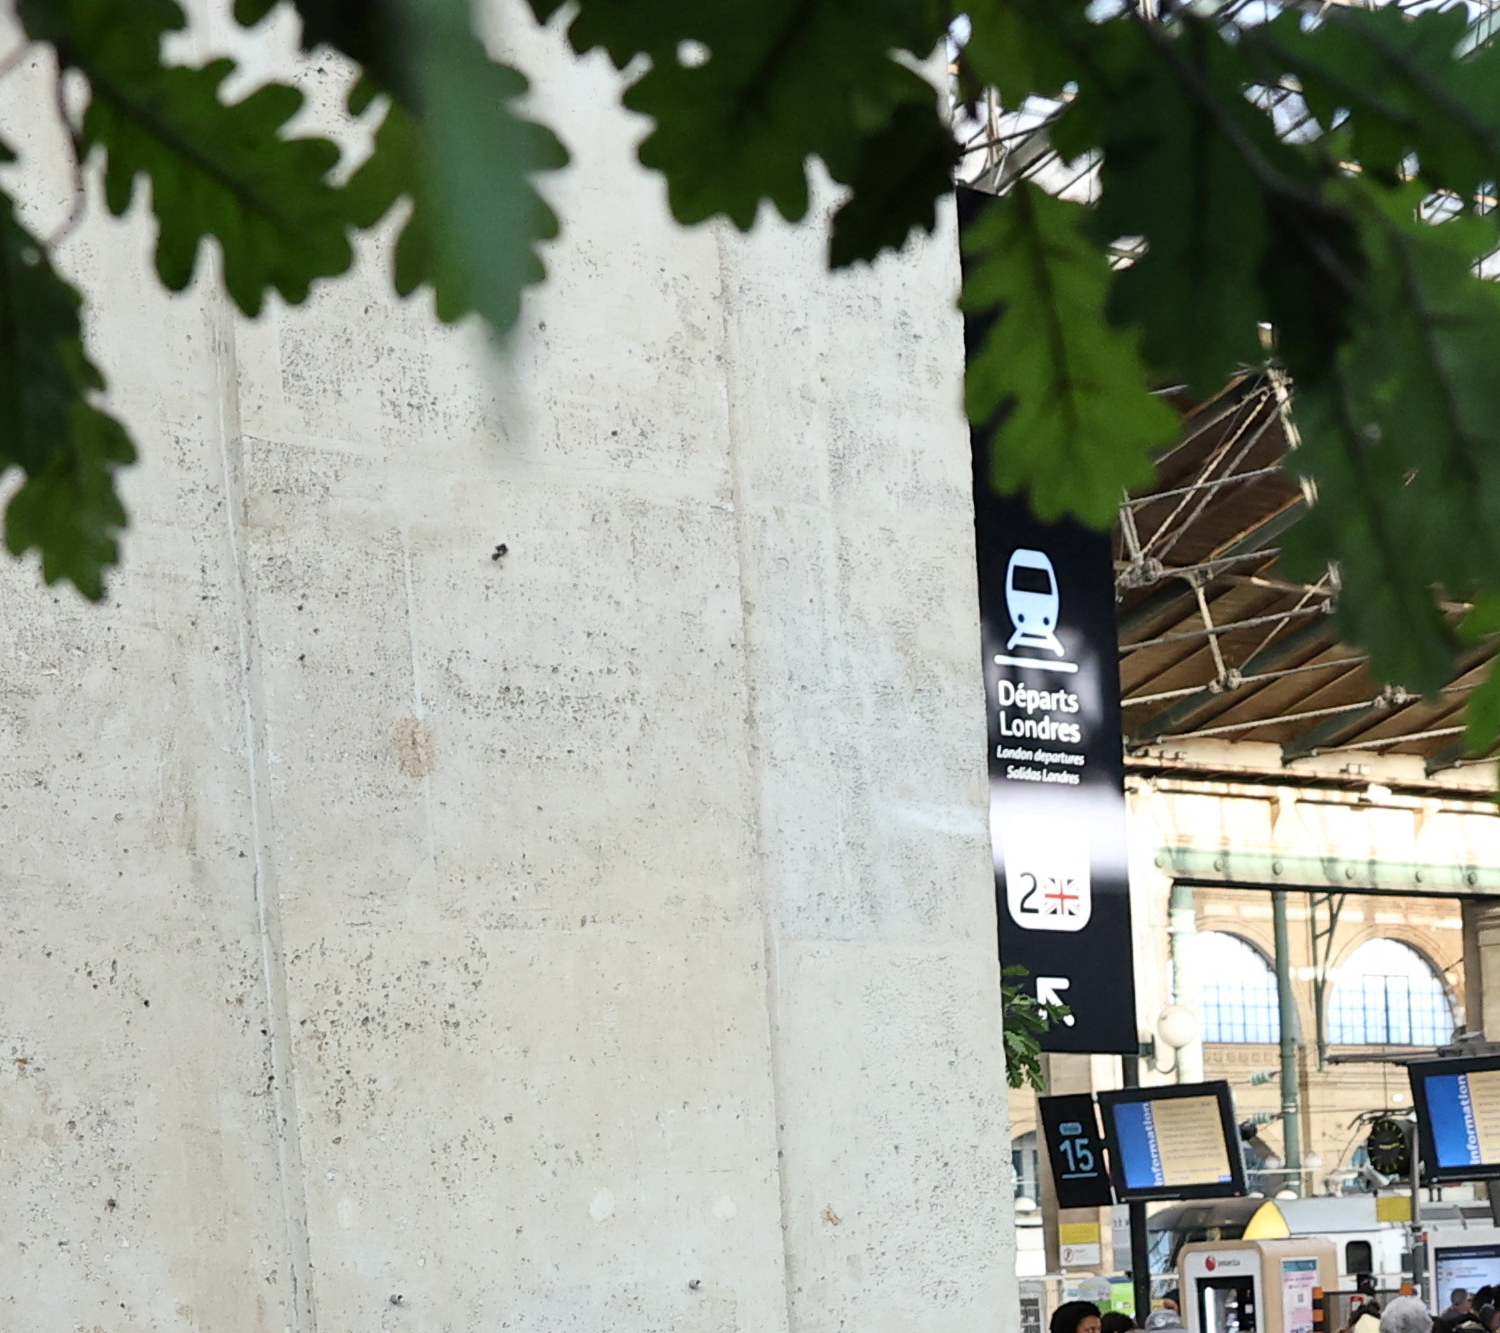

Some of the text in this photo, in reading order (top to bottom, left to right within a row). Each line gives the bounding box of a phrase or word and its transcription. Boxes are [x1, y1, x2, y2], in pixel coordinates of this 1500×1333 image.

[998, 680, 1079, 714] Départs
[1000, 710, 1081, 743] Londres
[997, 744, 1085, 766] London departures
[1042, 769, 1080, 785] Londres
[1019, 871, 1040, 915] 2
[1457, 1074, 1482, 1165] Information
[1058, 1137, 1095, 1172] 15
[1141, 1101, 1165, 1186] Information
